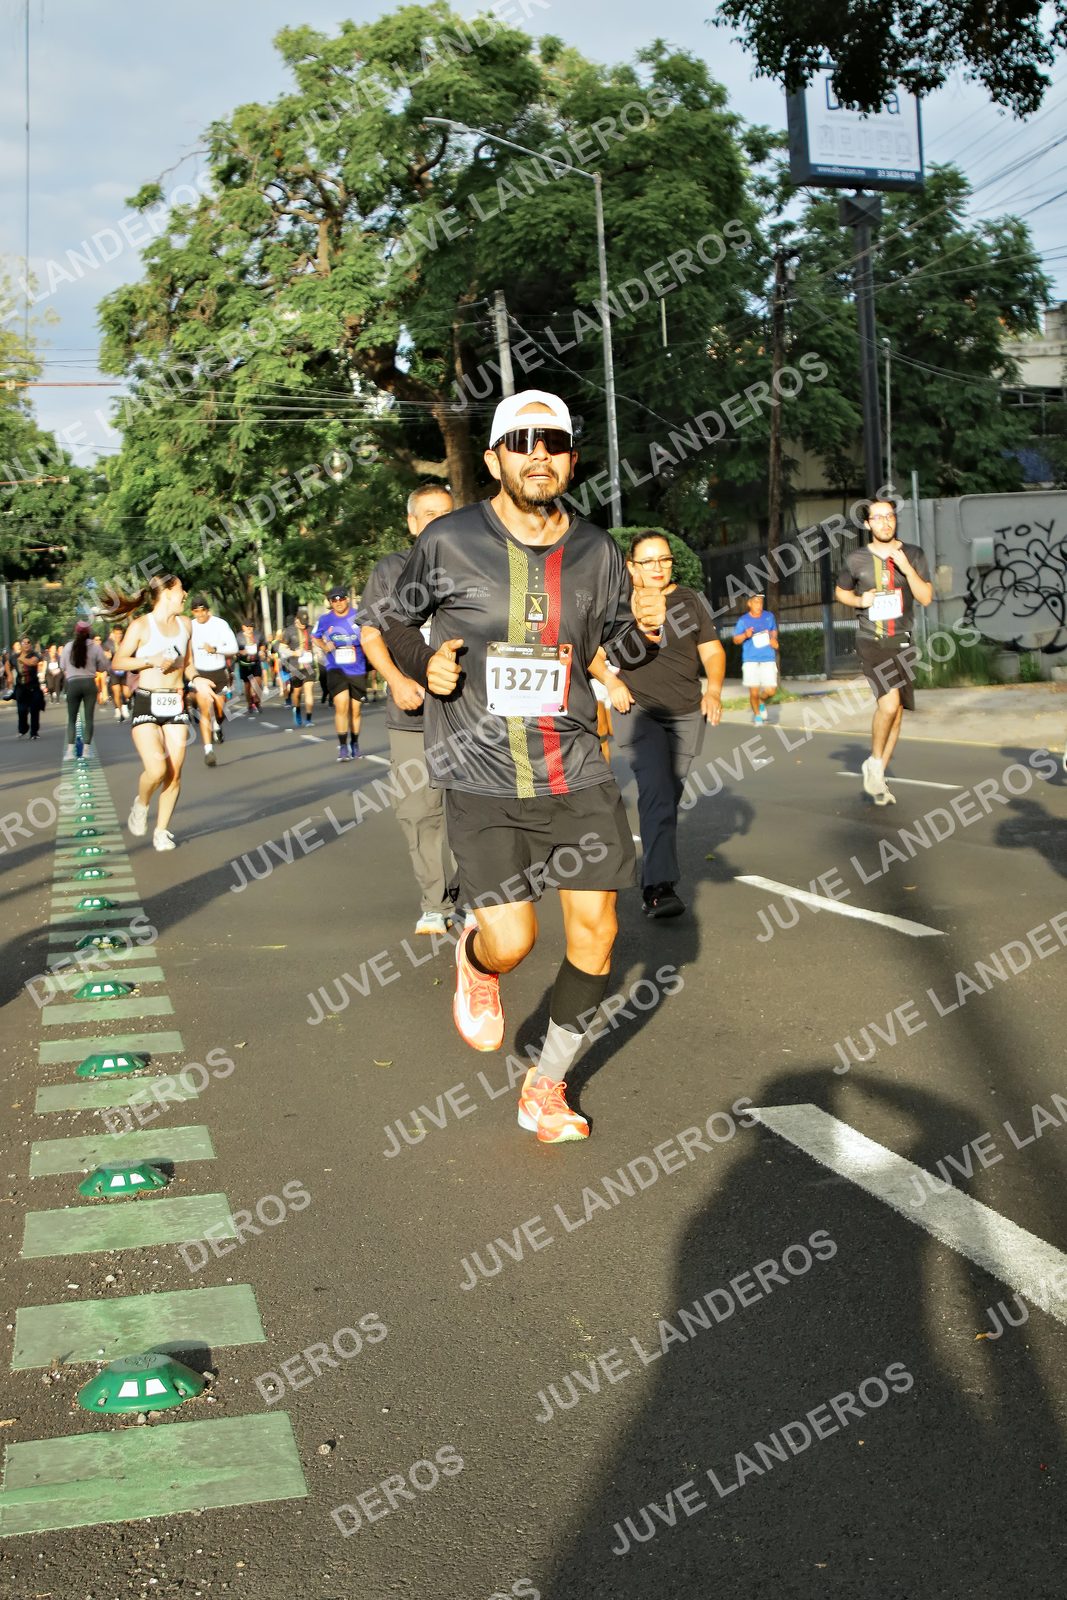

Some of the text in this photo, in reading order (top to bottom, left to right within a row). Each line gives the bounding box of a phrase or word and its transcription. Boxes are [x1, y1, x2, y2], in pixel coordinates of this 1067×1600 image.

[994, 519, 1055, 542] TOY
[491, 667, 560, 692] 13271
[156, 696, 178, 706] 8296
